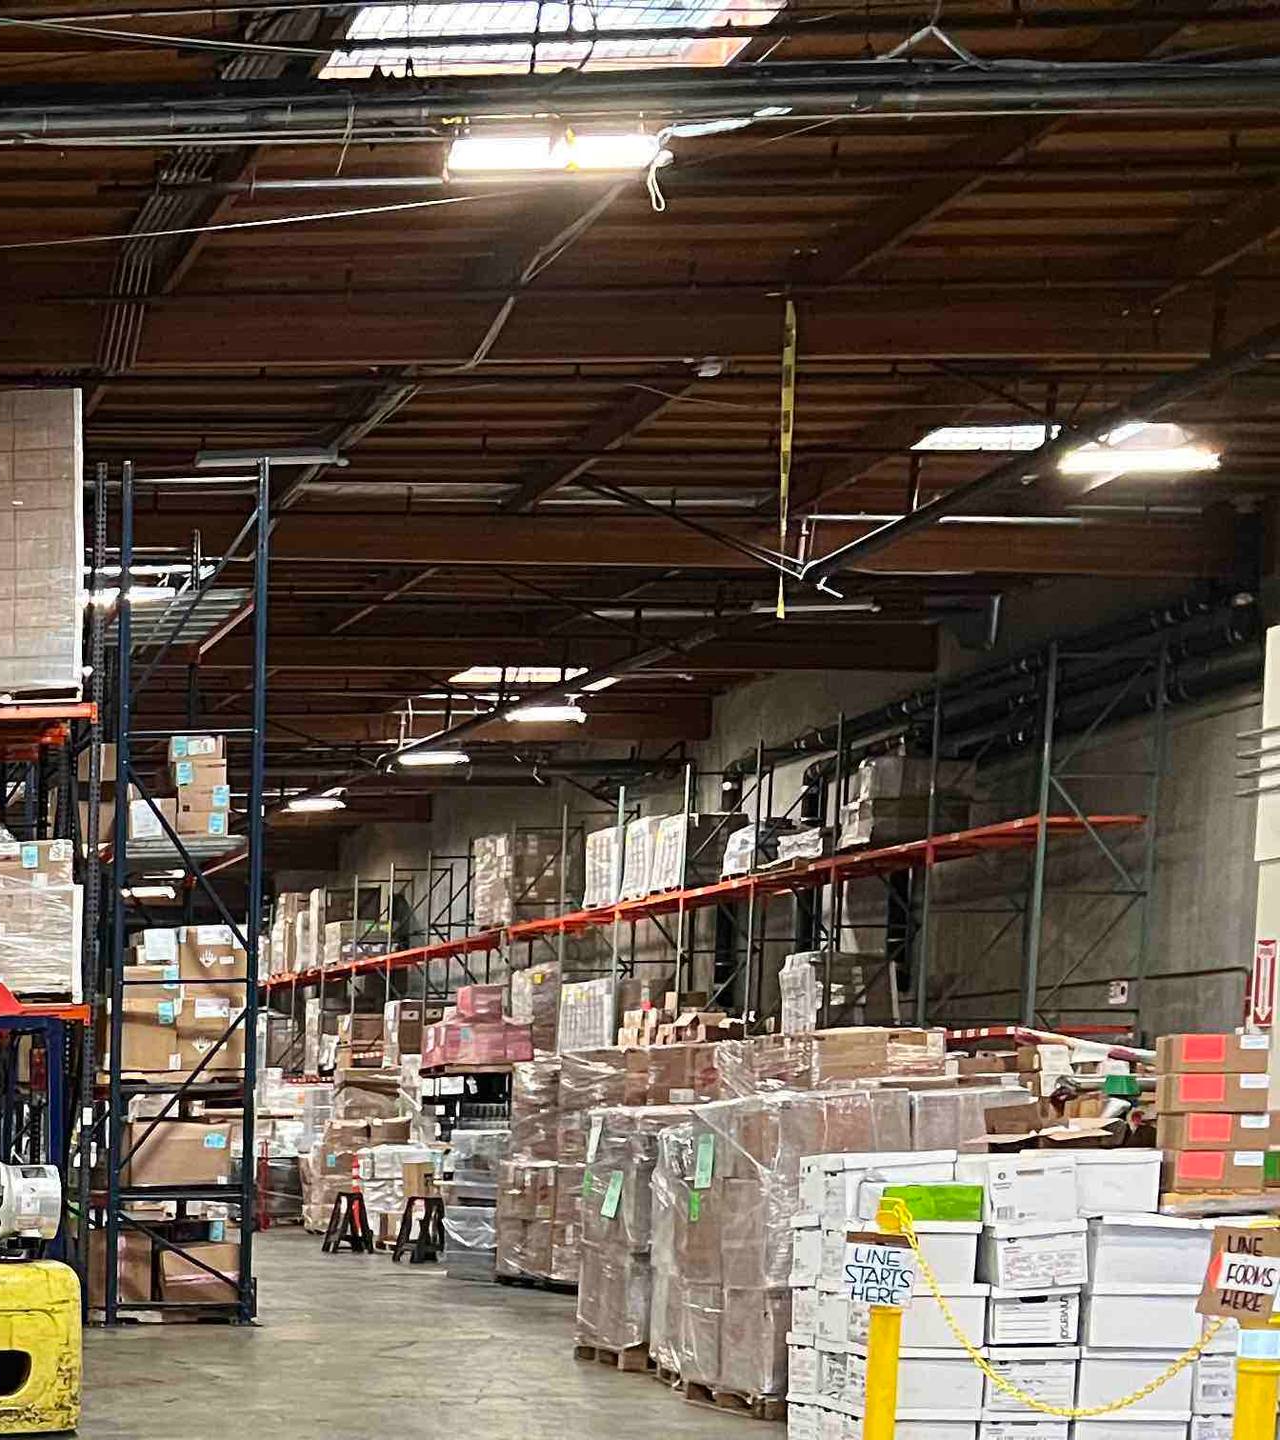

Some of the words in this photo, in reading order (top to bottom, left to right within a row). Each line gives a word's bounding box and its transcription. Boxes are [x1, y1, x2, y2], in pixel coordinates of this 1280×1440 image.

[854, 1247, 901, 1266] LINE
[1227, 1235, 1263, 1256] LINE
[844, 1265, 913, 1289] STARTS
[1226, 1264, 1278, 1288] FORMS
[851, 1286, 900, 1305] HERE
[1221, 1289, 1265, 1312] HERE
